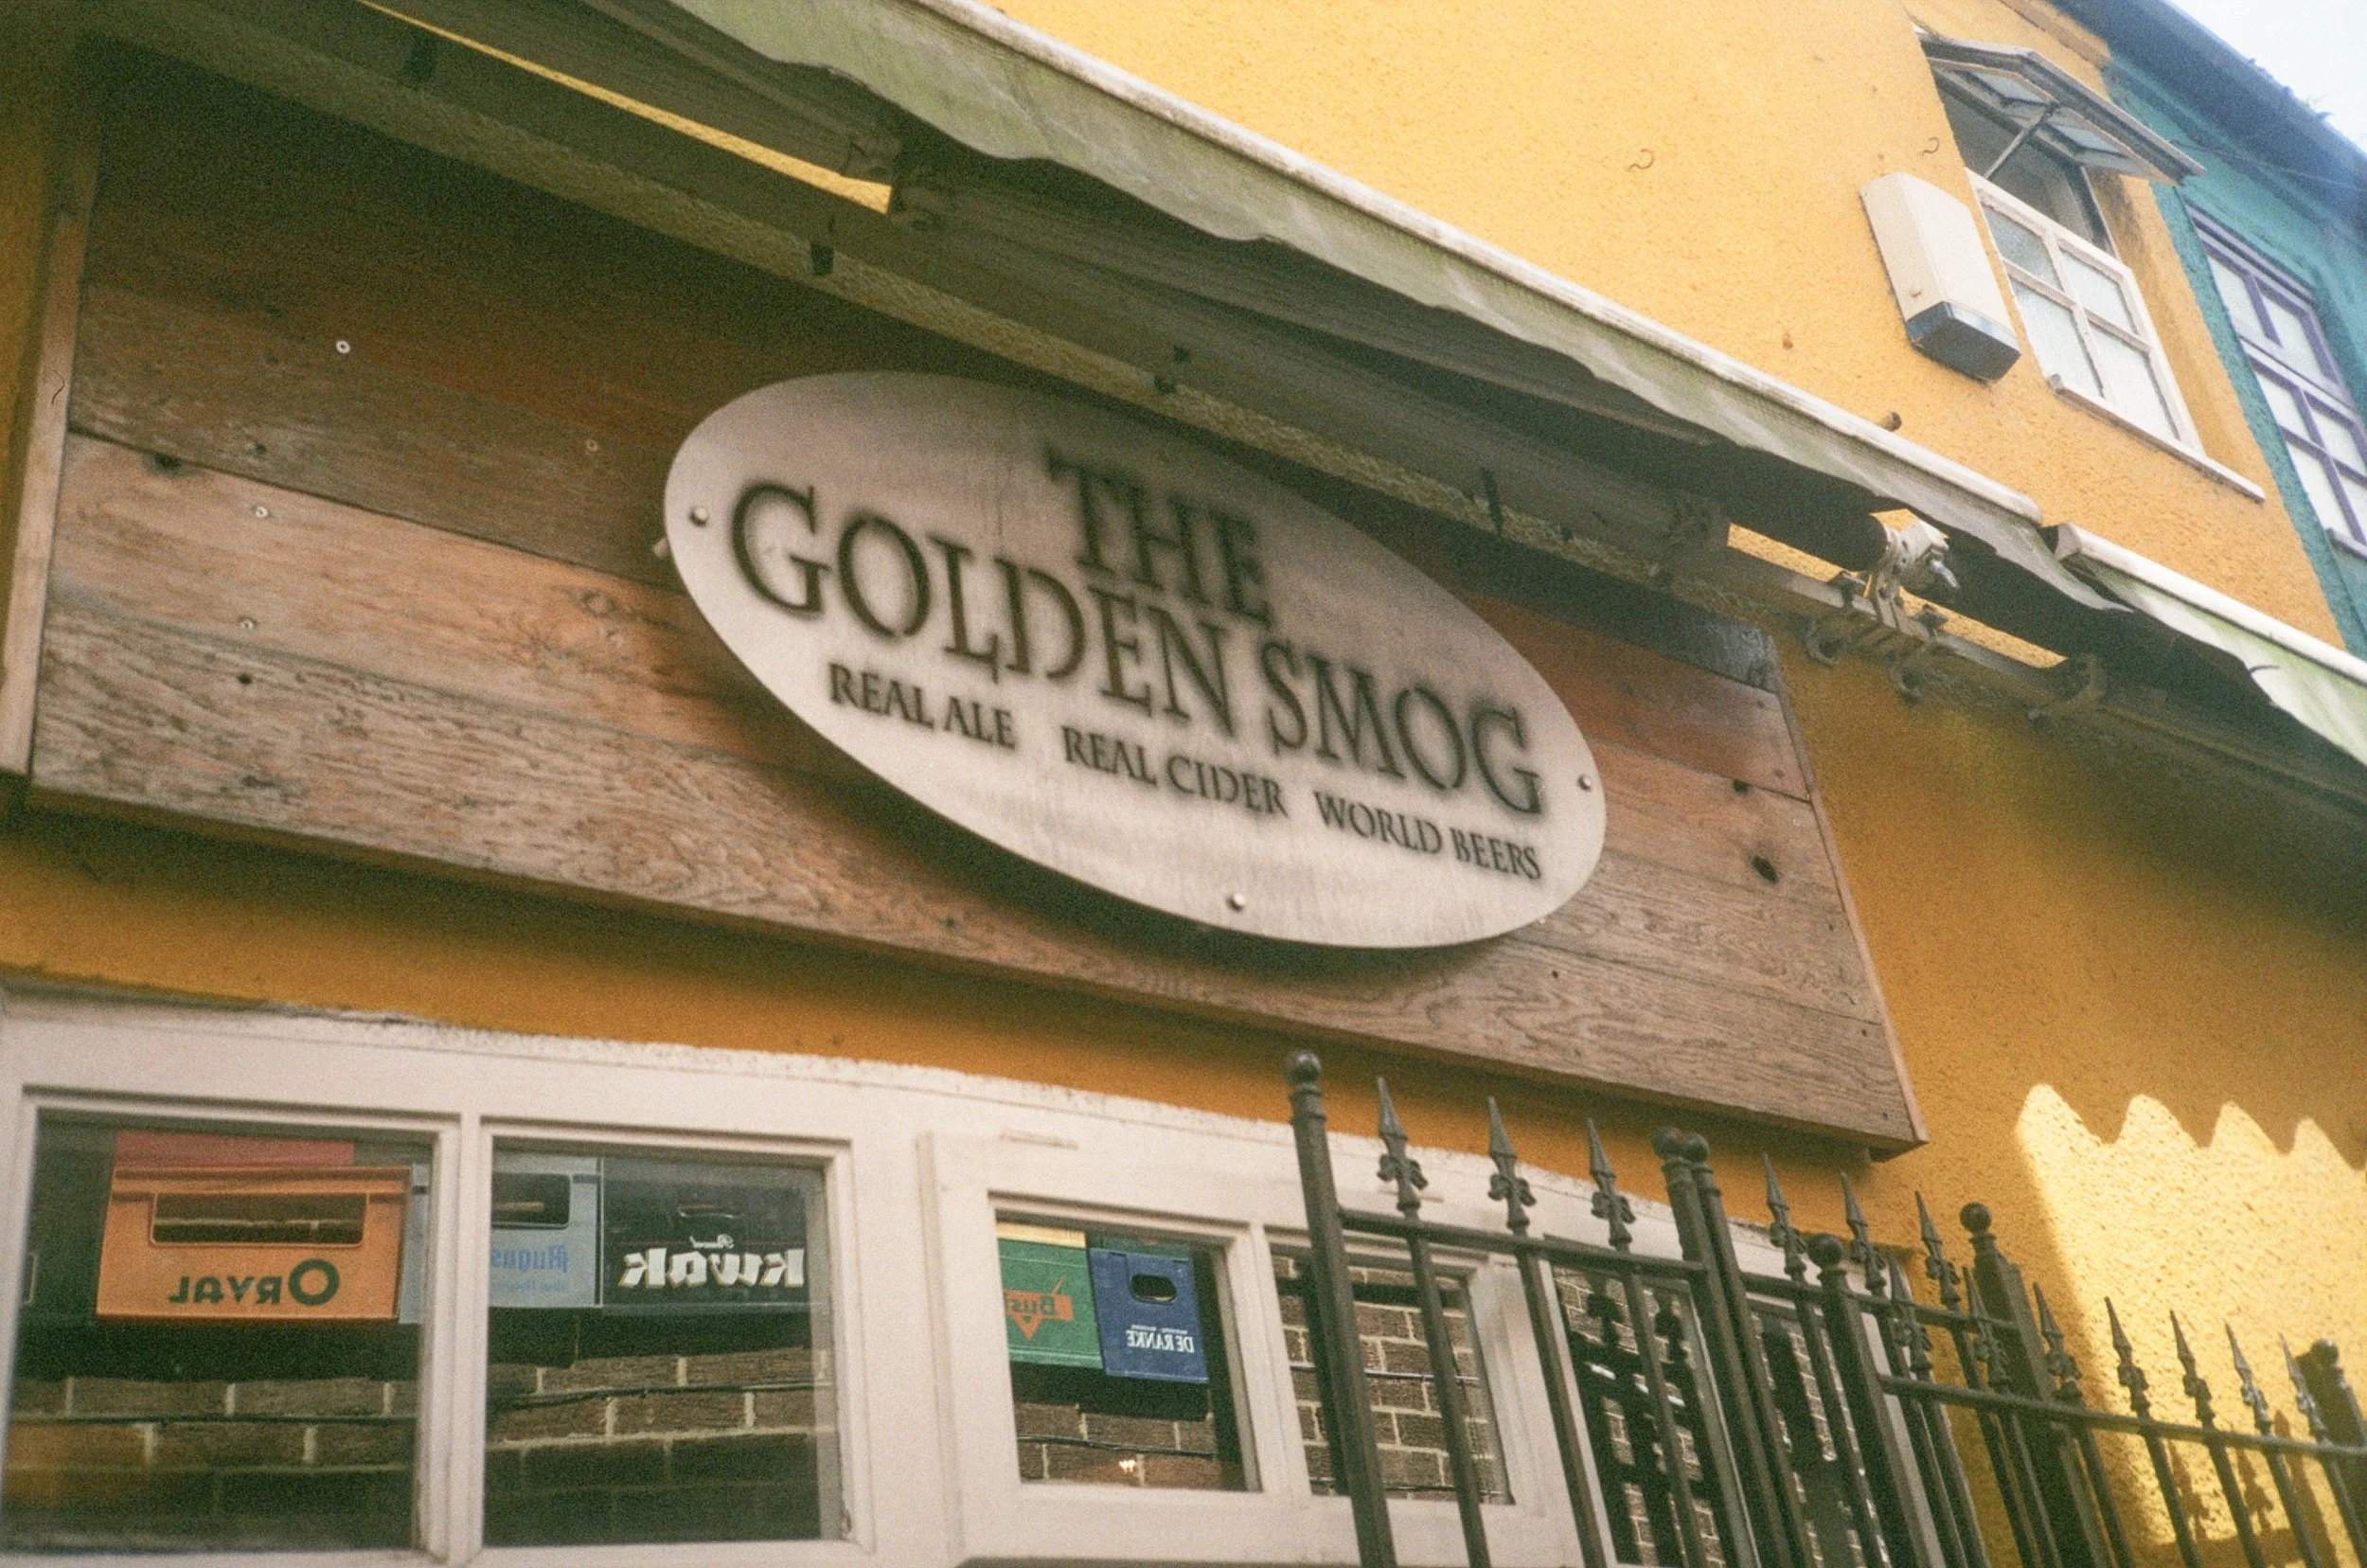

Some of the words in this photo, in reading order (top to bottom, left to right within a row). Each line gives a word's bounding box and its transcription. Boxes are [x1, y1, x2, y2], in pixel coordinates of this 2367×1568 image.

[1045, 443, 1272, 630] THE
[730, 479, 1236, 738] GOLDEN
[1257, 638, 1544, 816] SMOG
[828, 662, 935, 731] REAL
[943, 694, 1017, 751] ALE
[1061, 725, 1157, 787] REAL
[1166, 754, 1289, 819] CIDER
[1313, 791, 1444, 856] WORLD
[1449, 824, 1542, 882] BEERS
